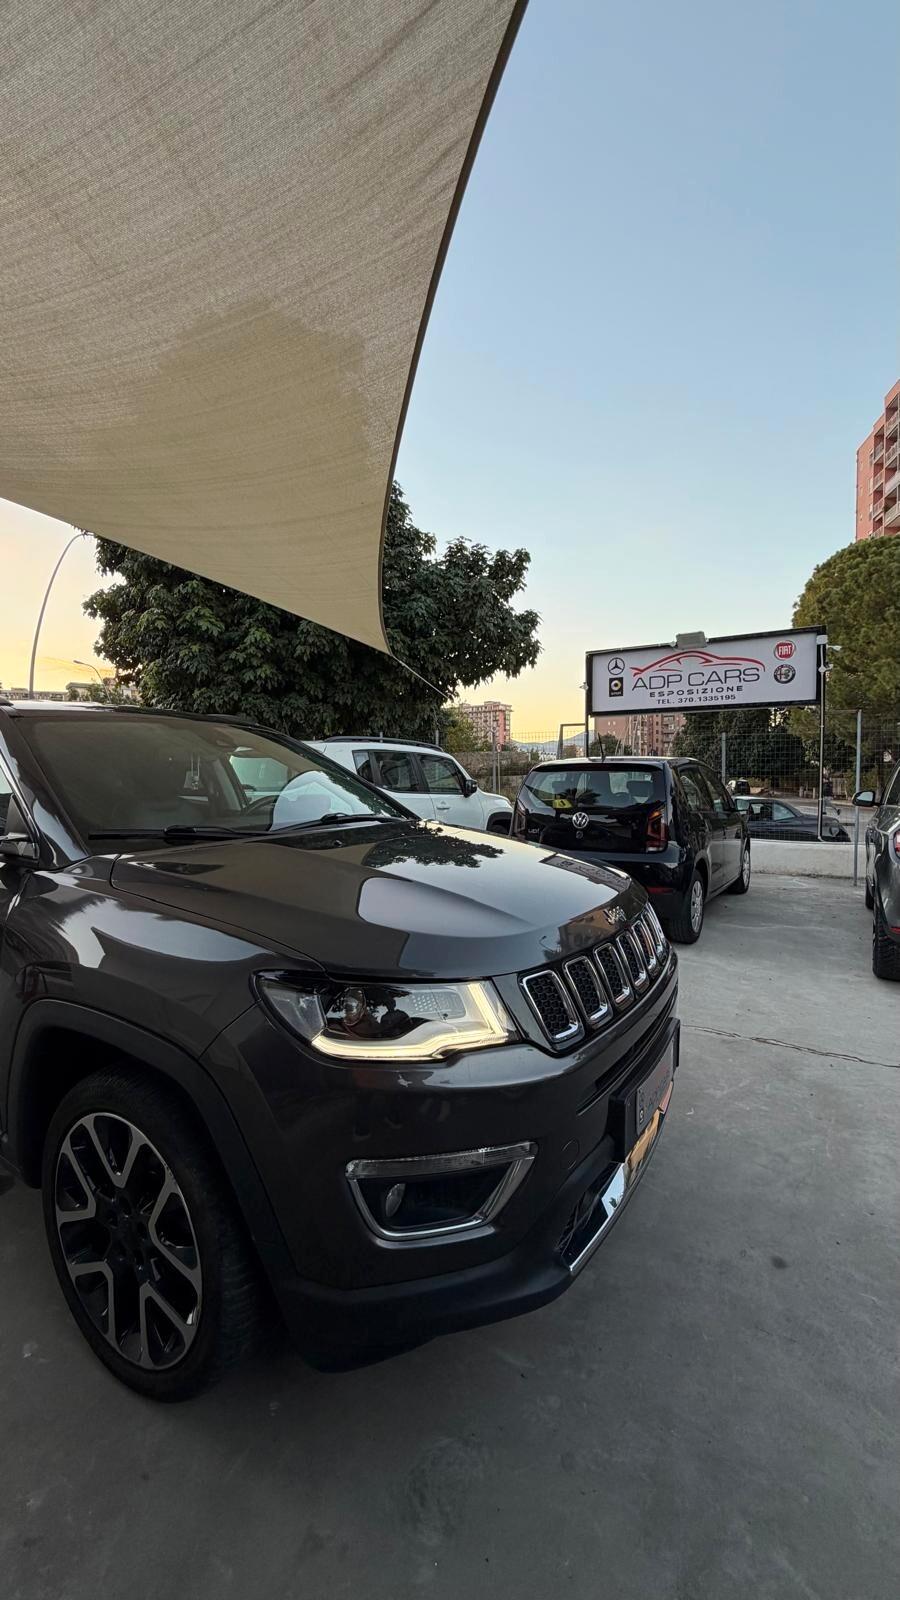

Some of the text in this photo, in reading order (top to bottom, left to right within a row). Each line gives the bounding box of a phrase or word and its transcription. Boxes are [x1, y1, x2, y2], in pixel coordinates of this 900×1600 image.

[778, 644, 792, 656] FIAT
[631, 674, 683, 691] ADP
[687, 667, 760, 686] CARS
[649, 685, 743, 698] ESPOSIZIONE
[677, 694, 737, 704] 370.1335195
